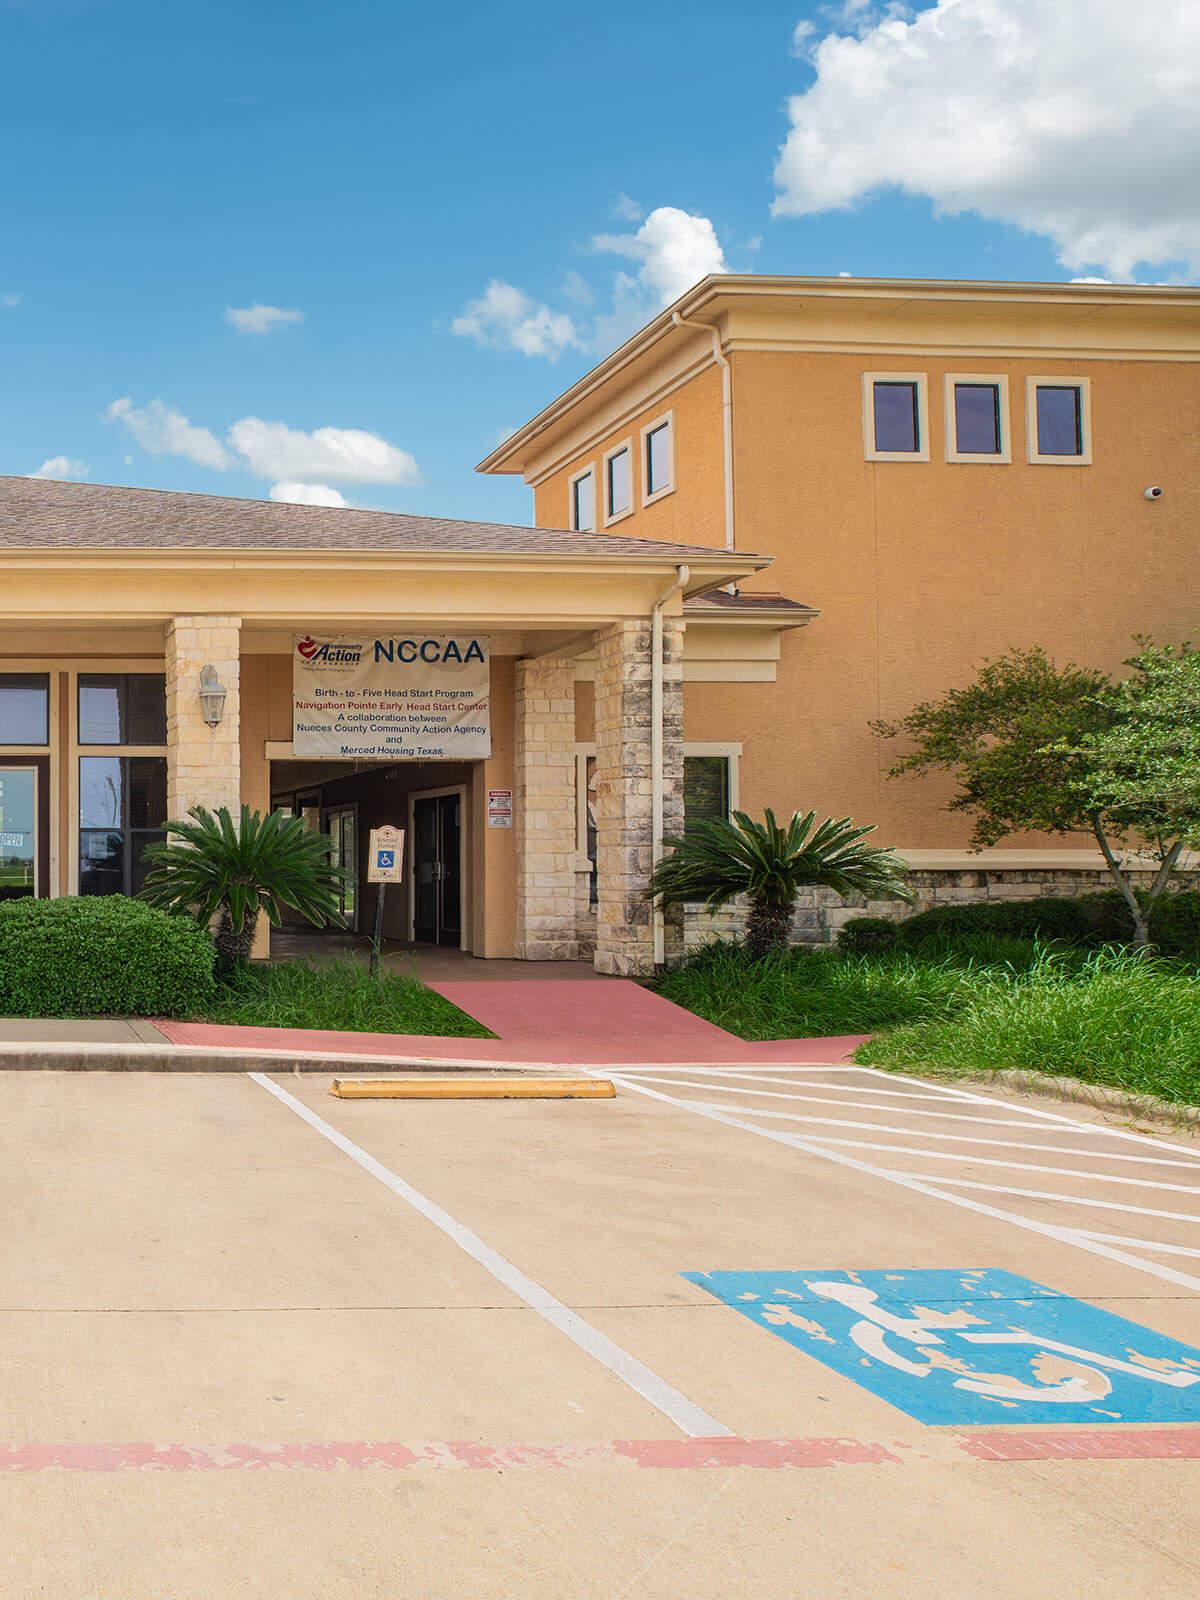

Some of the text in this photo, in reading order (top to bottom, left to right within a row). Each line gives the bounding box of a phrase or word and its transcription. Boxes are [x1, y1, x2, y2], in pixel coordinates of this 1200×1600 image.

[312, 643, 361, 661] Action
[374, 639, 485, 663] NCCAA
[315, 688, 338, 697] Birth
[345, 689, 355, 697] to
[363, 689, 382, 697] Five
[384, 689, 408, 697] Head
[410, 689, 433, 698] Start
[435, 690, 474, 699] Program
[296, 701, 346, 711] Navigation
[380, 702, 402, 712] Early
[406, 703, 431, 711] Head
[432, 703, 455, 711] Start
[458, 703, 487, 712] Center
[338, 713, 447, 722] A collaboration between
[297, 723, 487, 735] Nueces County Community Action Agency
[340, 746, 375, 754] Merced
[378, 746, 415, 756] Housing
[0, 833, 22, 845] OPEN
